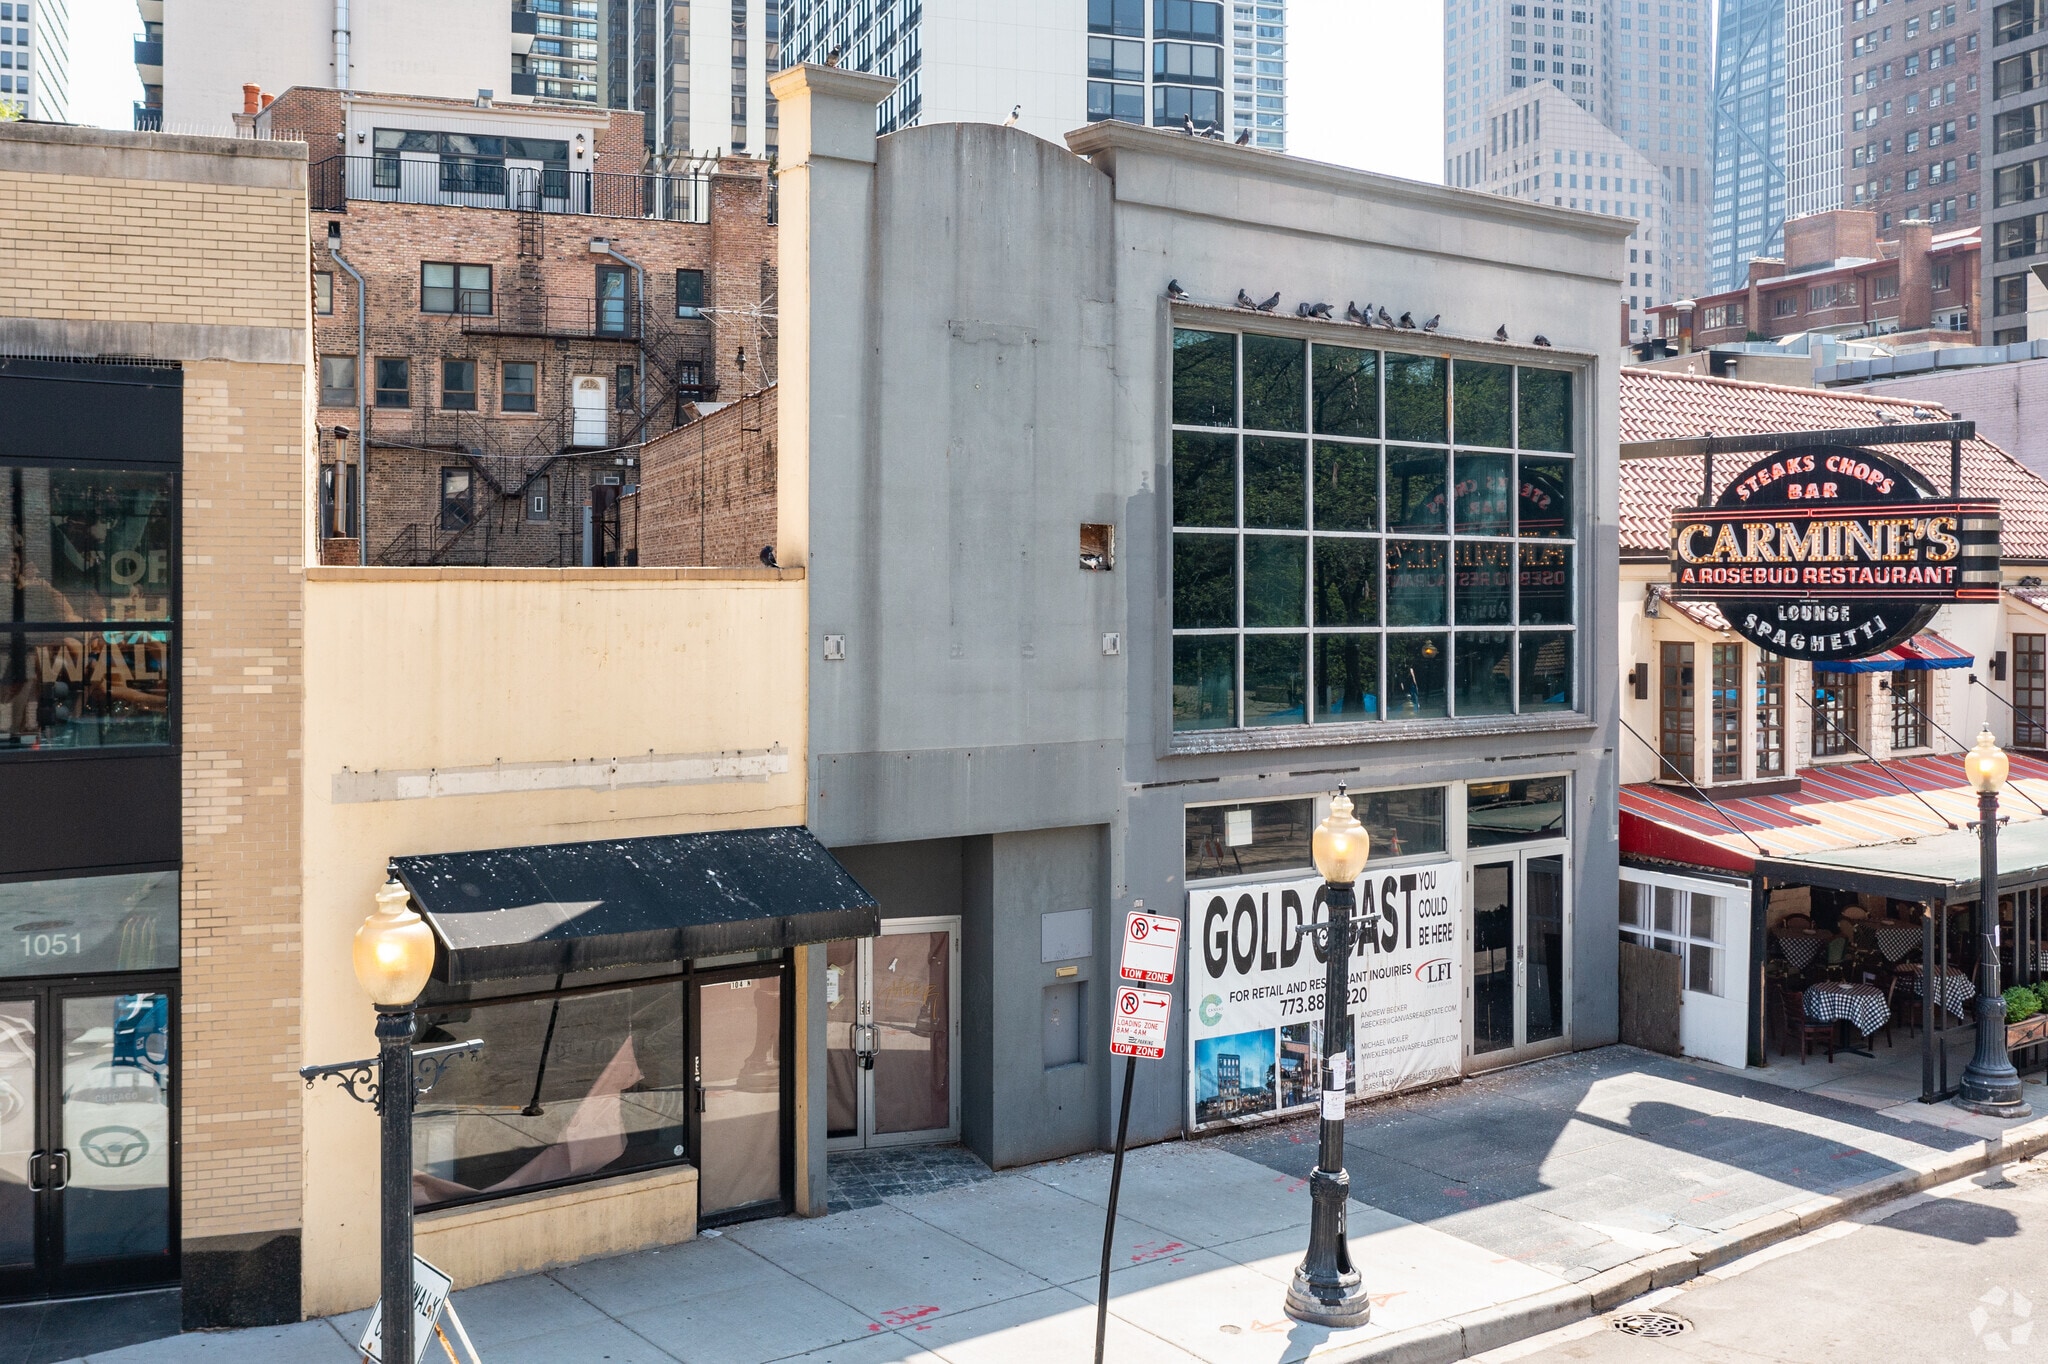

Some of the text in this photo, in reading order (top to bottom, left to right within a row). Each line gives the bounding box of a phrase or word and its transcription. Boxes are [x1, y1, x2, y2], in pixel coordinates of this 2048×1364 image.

[1735, 455, 1895, 501] STEAKS CHOPS
[1787, 482, 1838, 500] BAR
[1677, 517, 1960, 565] CARMINE'S
[1681, 566, 1957, 584] A ROSEBUD RESTAURANT
[1777, 605, 1850, 622] LOUNGE
[1742, 614, 1887, 652] SPAGHETTI
[1419, 871, 1437, 891] YOU
[1419, 896, 1448, 918] COULD
[1203, 889, 1303, 979] GOLD
[1419, 922, 1453, 946] BE HERE
[20, 933, 82, 957] 1051
[1124, 968, 1169, 982] TOW ZONE
[1427, 962, 1452, 983] LFI
[1229, 963, 1412, 1003] FOR RETAIL AND RESANT INQUIRIES
[1360, 1004, 1408, 1019] ANDREW BECKER
[1117, 1018, 1159, 1031] LOADING ZONE
[1115, 1044, 1159, 1057] TOW ZONE
[1361, 1034, 1409, 1050] MICHAEL WEXLER
[1362, 1067, 1395, 1082] JOHN BASSI
[95, 1092, 138, 1103] CHICAGO
